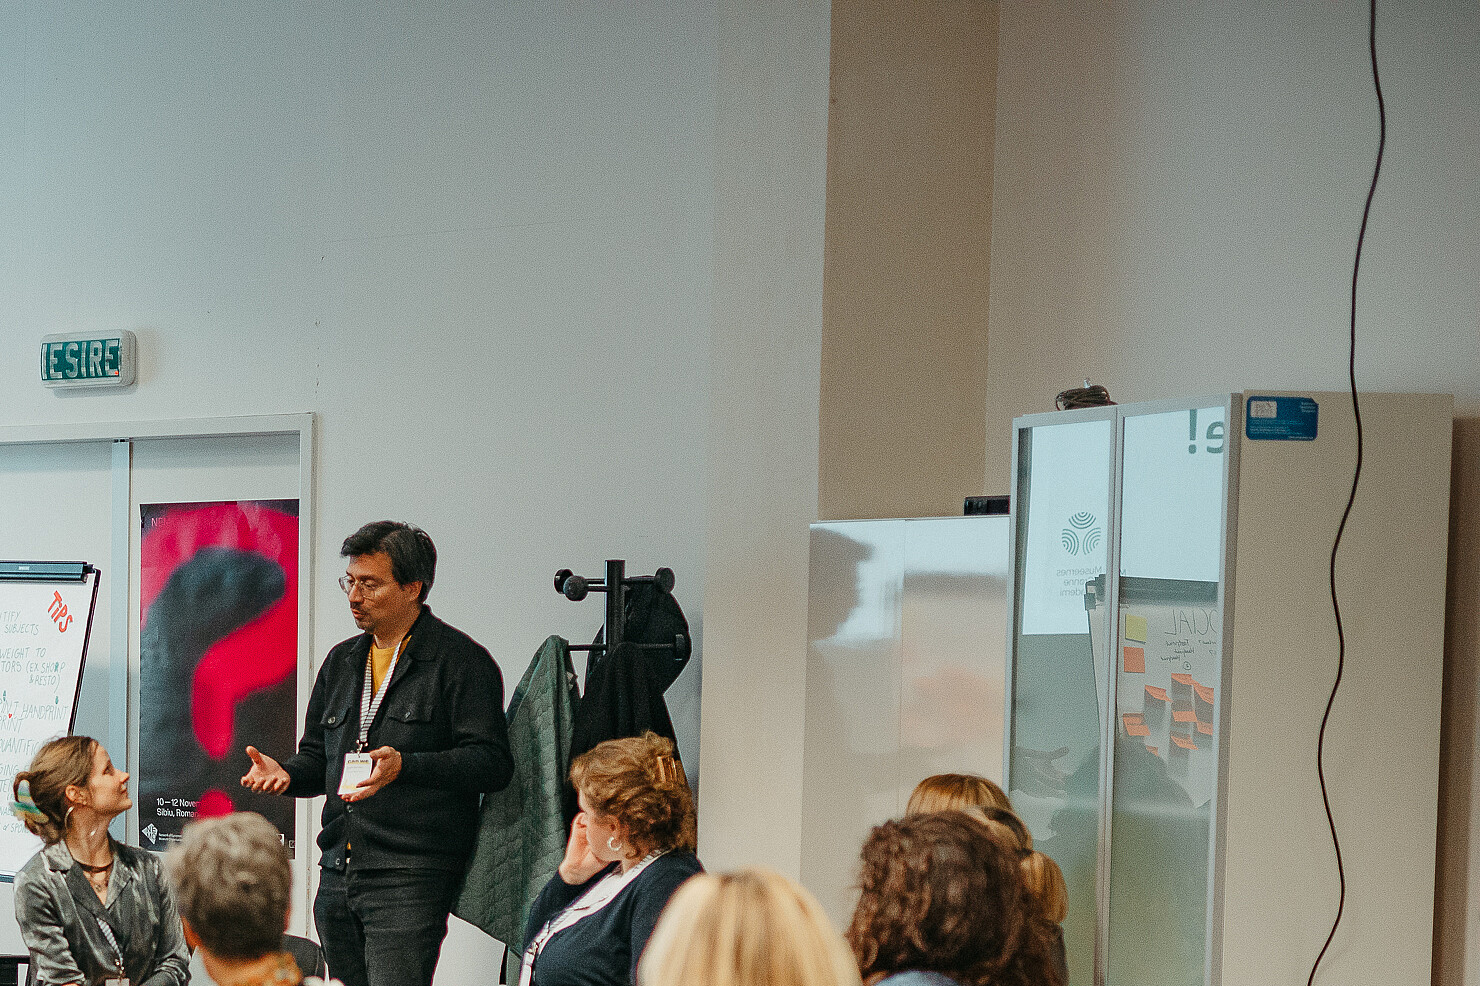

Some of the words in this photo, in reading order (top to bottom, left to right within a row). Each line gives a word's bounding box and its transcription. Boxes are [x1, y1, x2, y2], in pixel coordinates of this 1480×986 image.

[4, 623, 39, 636] SUBJECTS
[0, 647, 30, 660] WEIGHT
[36, 647, 46, 658] TO
[21, 703, 69, 720] HANDPRINT
[156, 808, 175, 818] Sibiu,
